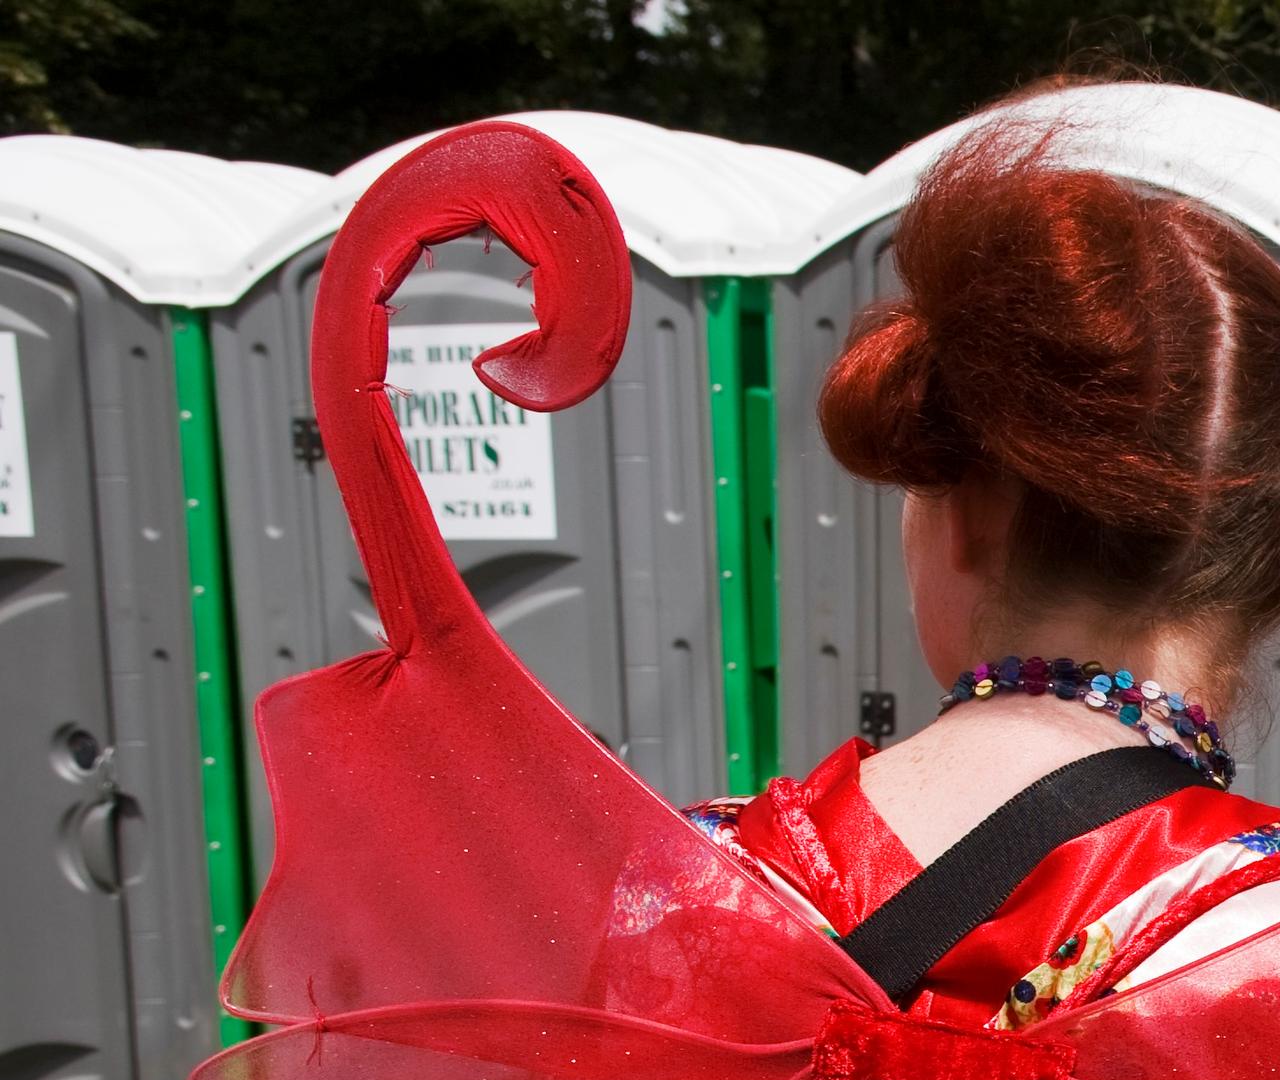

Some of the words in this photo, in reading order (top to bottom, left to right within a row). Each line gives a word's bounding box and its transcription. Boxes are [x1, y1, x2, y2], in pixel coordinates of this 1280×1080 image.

[389, 346, 413, 363] OR
[428, 344, 486, 363] HIR
[389, 391, 527, 428] MPORAR
[407, 437, 500, 475] ILETS
